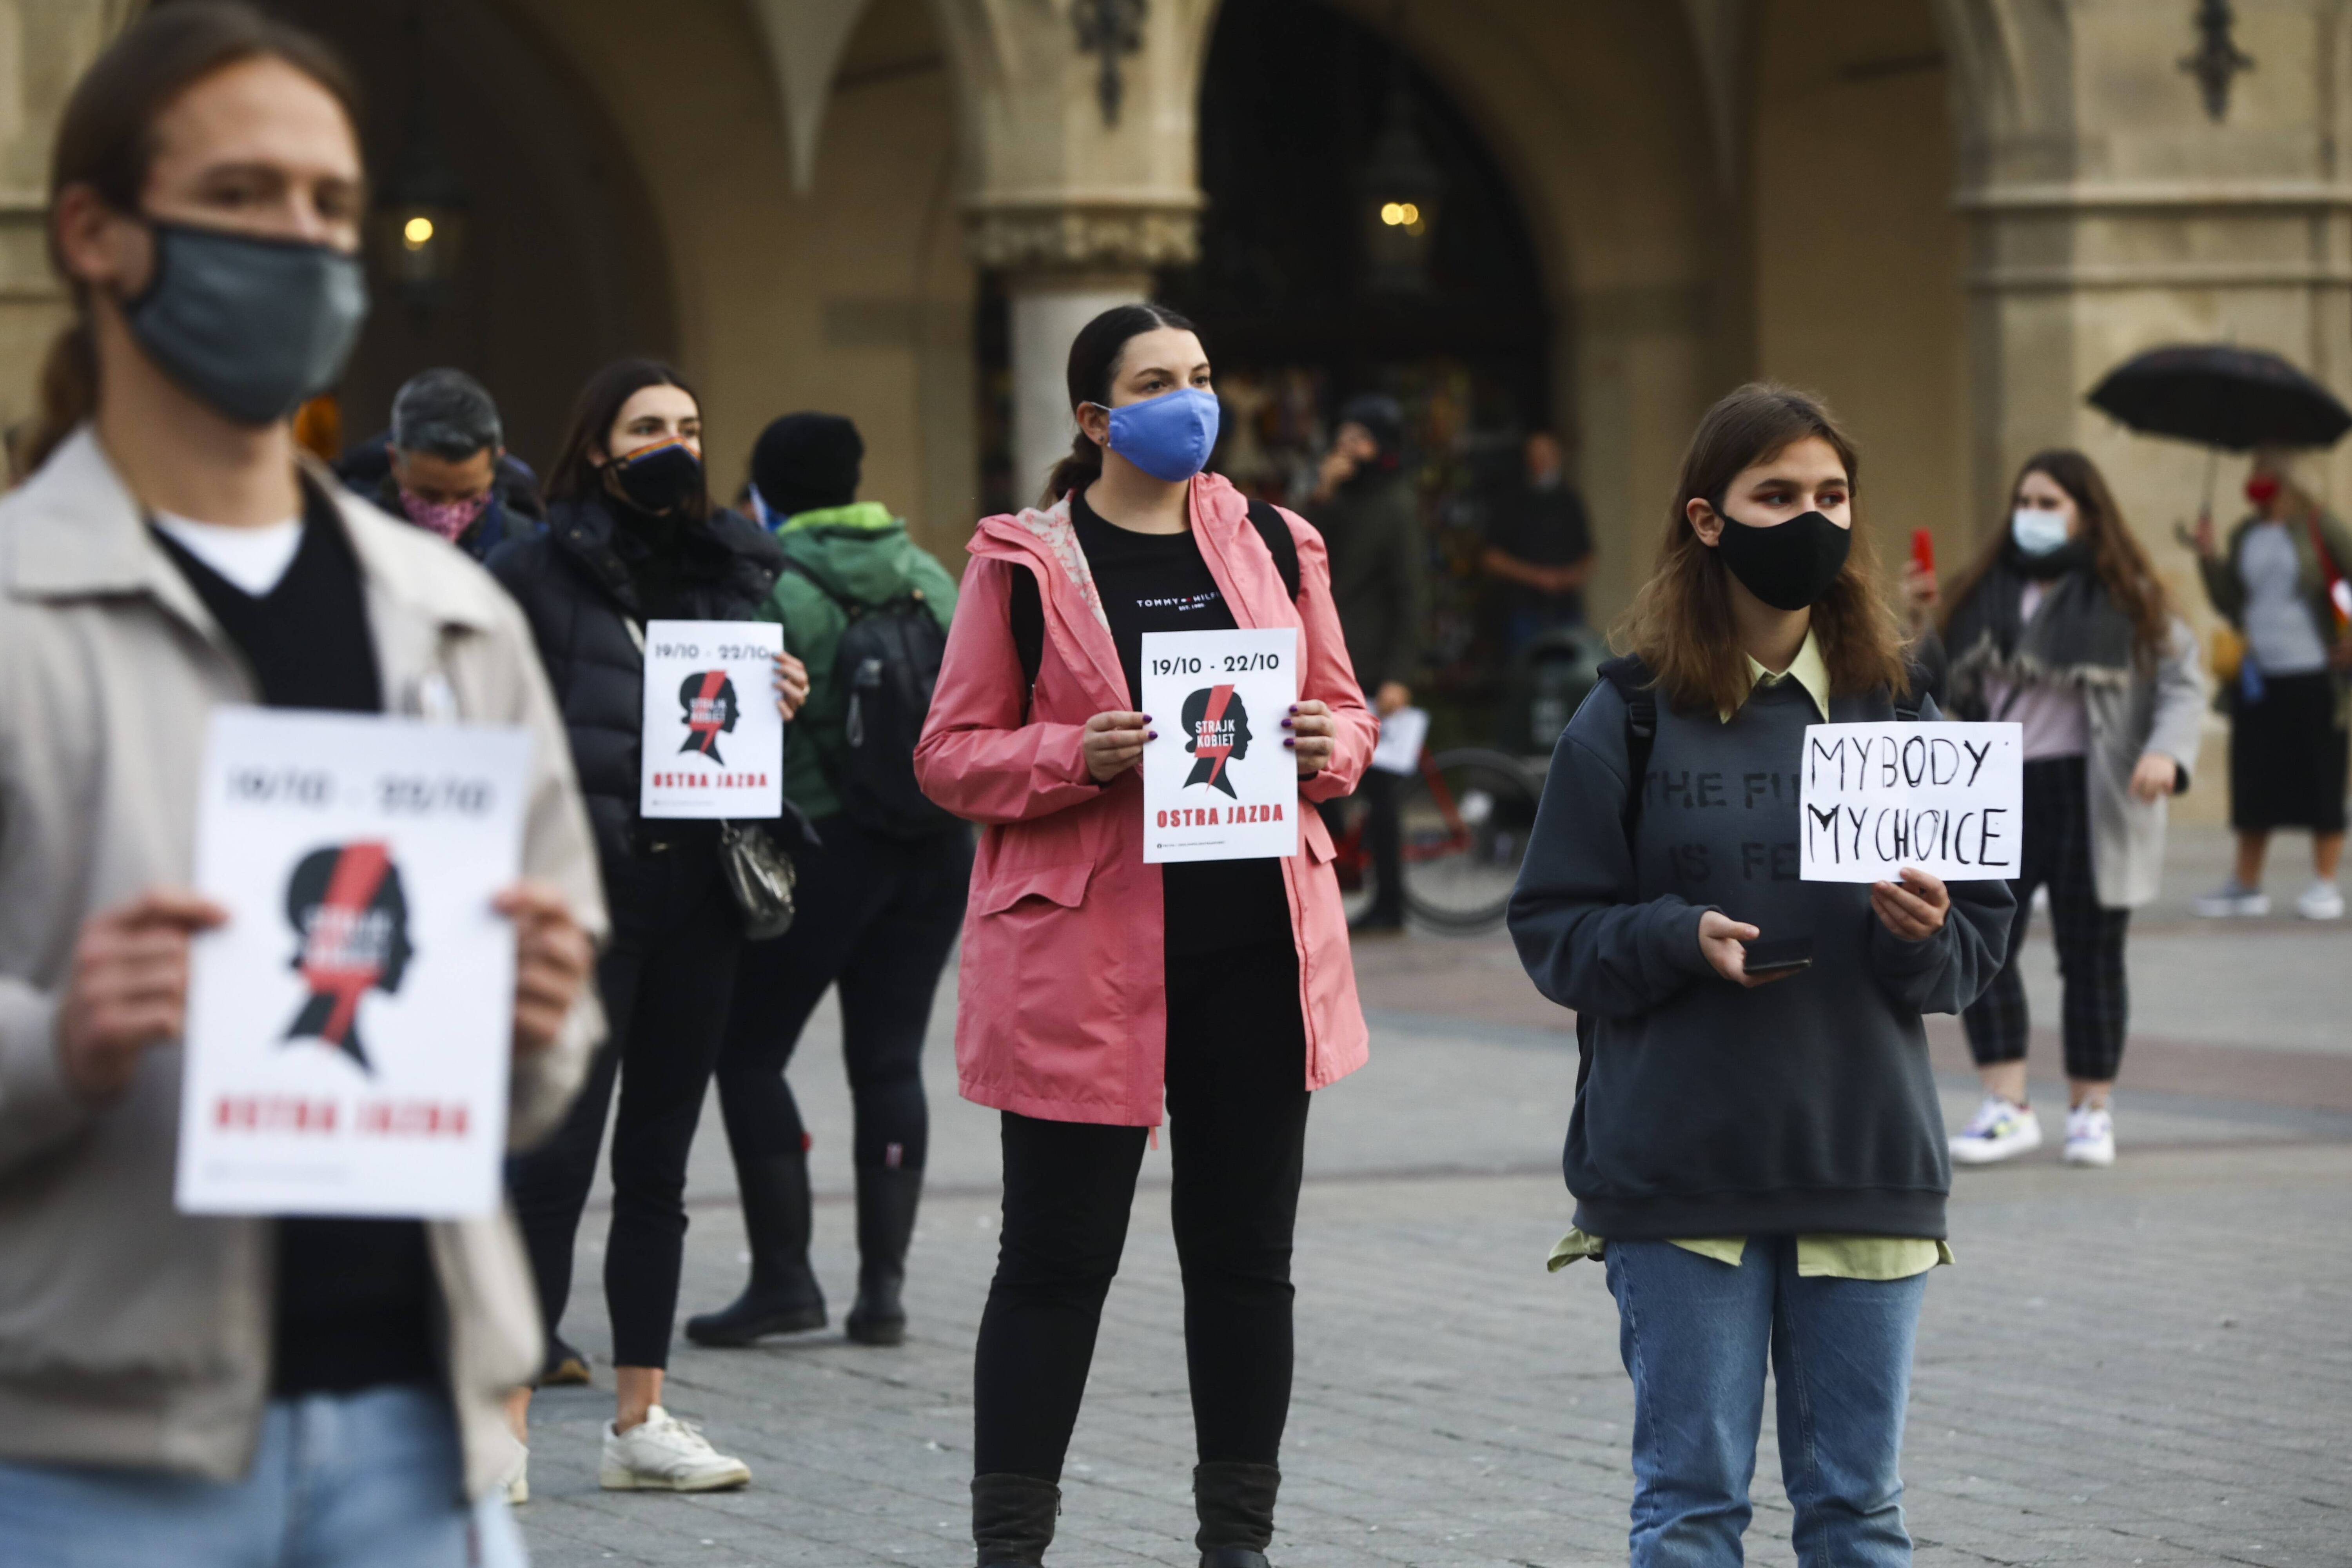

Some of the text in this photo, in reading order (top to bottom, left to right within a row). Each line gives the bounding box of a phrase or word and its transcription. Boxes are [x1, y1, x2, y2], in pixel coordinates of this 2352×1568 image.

[1136, 598, 1178, 607] TOMMY
[1152, 657, 1201, 675] 19/10
[1223, 653, 1279, 672] 22/10
[1196, 720, 1235, 734] STRAJK
[1197, 733, 1234, 748] KOBIET
[1645, 771, 1727, 809] THE
[1157, 804, 1283, 828] OSTRA JAZDA
[1668, 842, 1799, 883] IS FE
